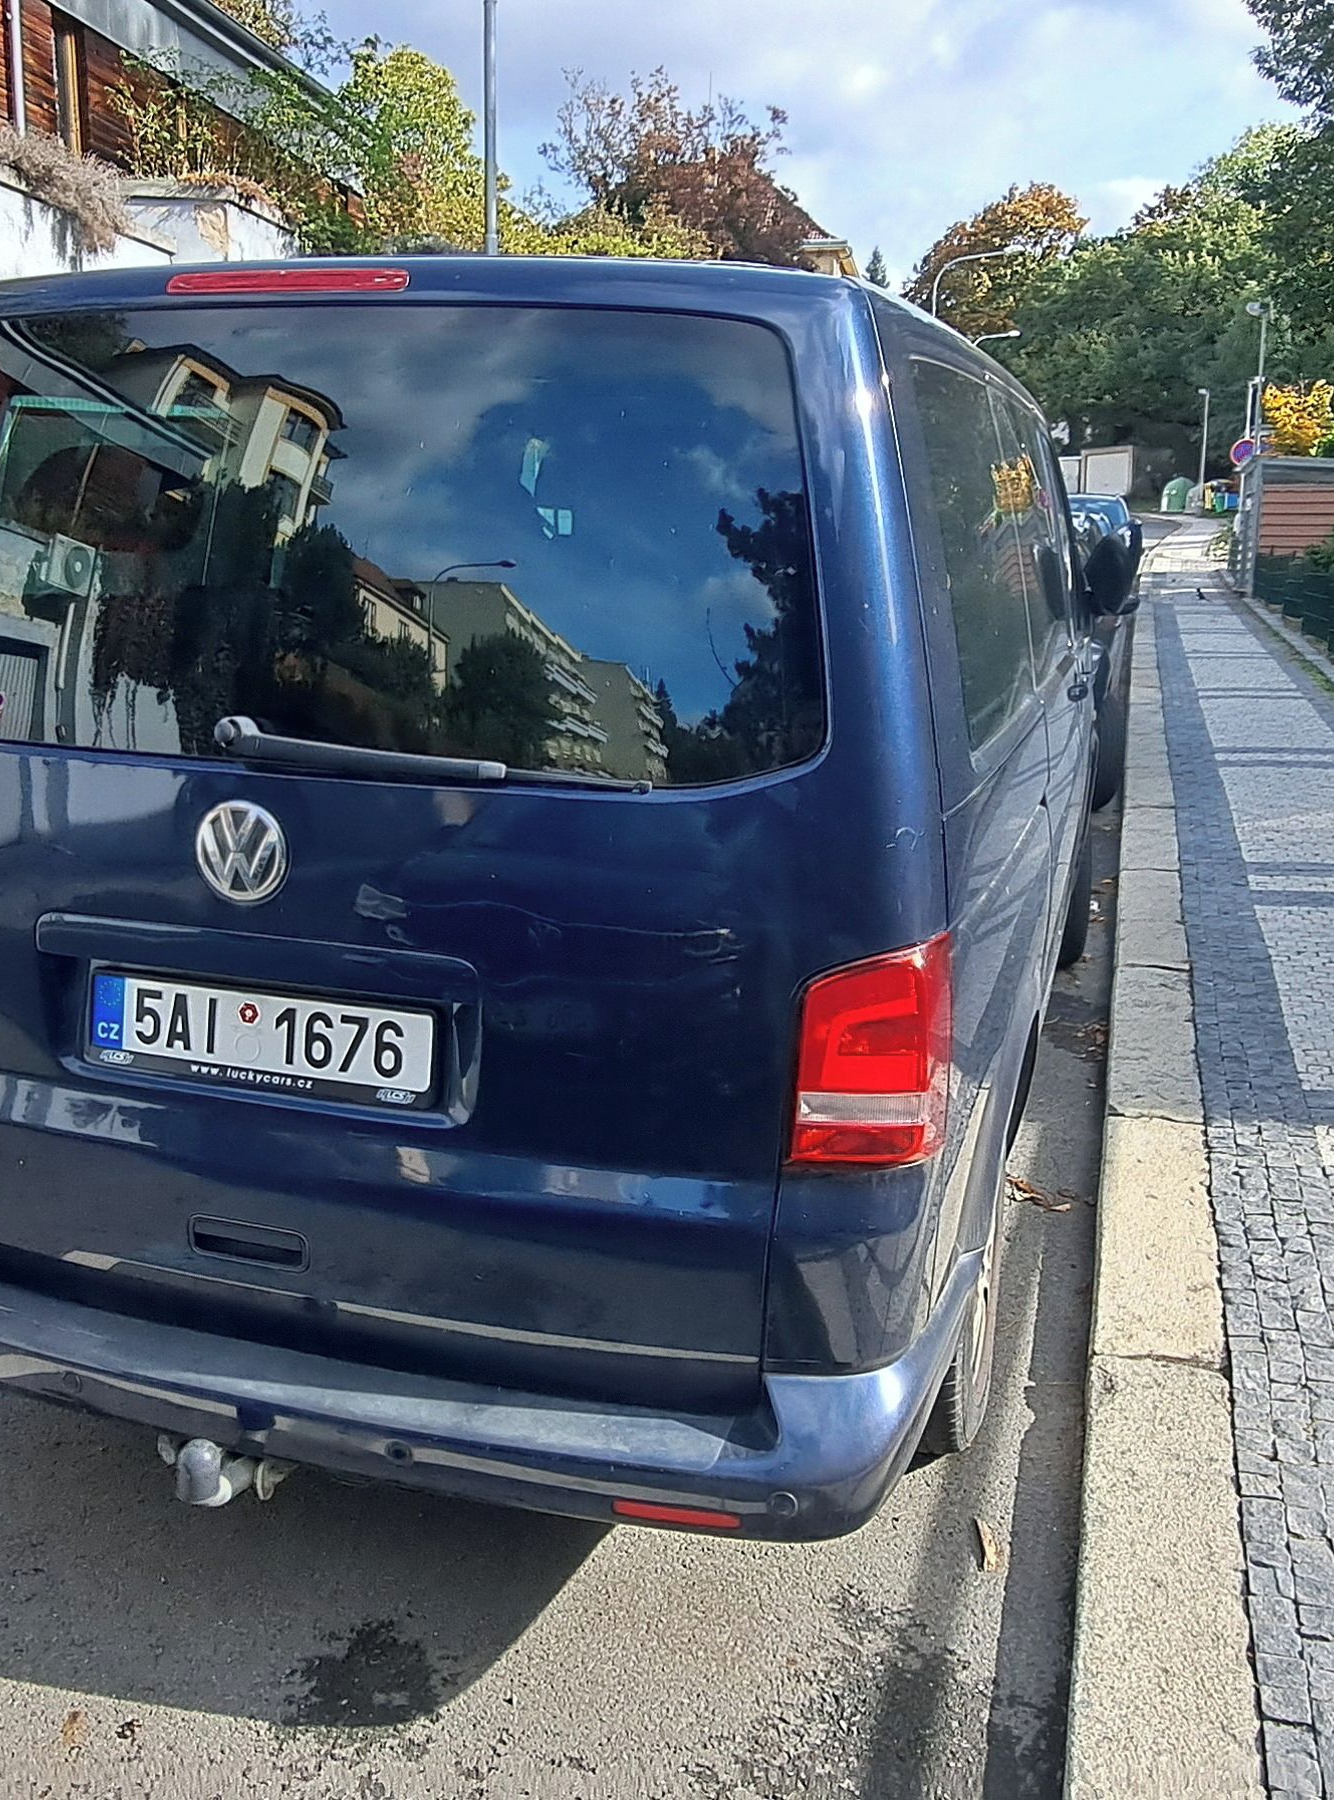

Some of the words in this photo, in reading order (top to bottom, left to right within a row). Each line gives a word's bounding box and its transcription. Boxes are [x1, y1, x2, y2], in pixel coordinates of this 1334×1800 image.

[97, 1020, 120, 1041] CZ
[134, 986, 218, 1055] 5AI
[274, 1006, 405, 1079] 1676
